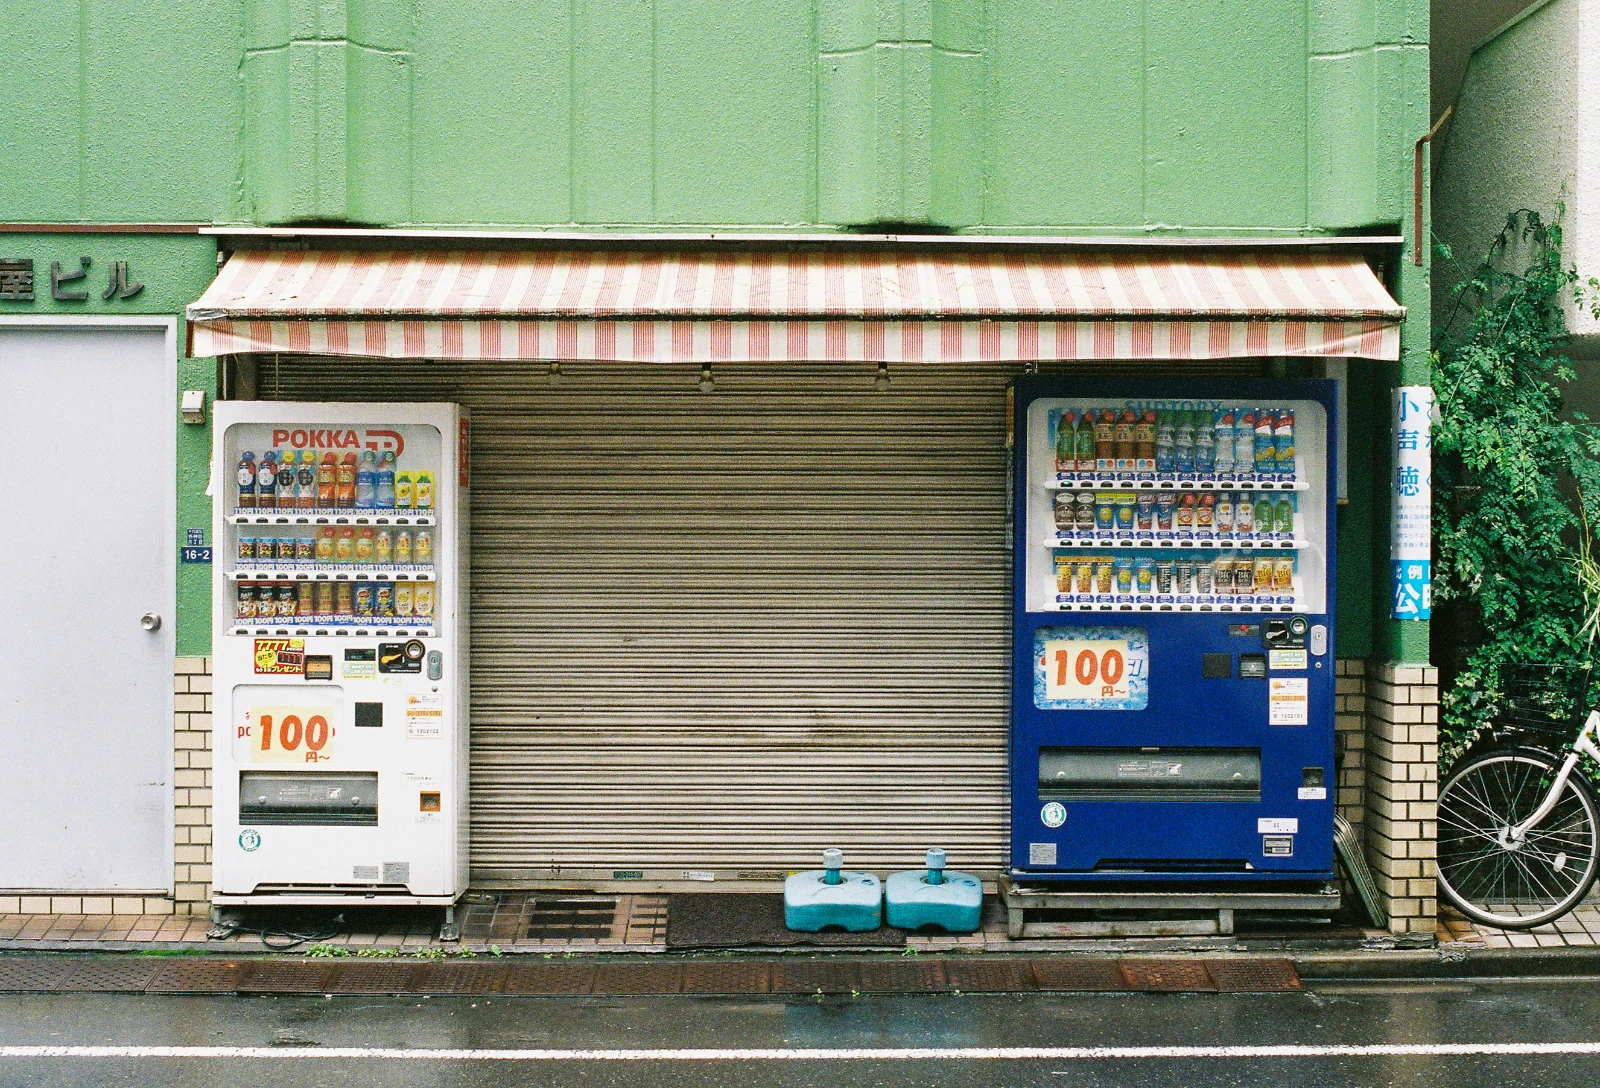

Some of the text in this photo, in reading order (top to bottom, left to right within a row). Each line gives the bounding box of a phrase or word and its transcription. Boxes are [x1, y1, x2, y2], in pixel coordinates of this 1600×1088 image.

[273, 429, 361, 449] POKKA
[185, 550, 210, 560] 16-2
[256, 640, 288, 650] 7777
[1056, 649, 1124, 686] 100
[260, 714, 328, 751] 100
